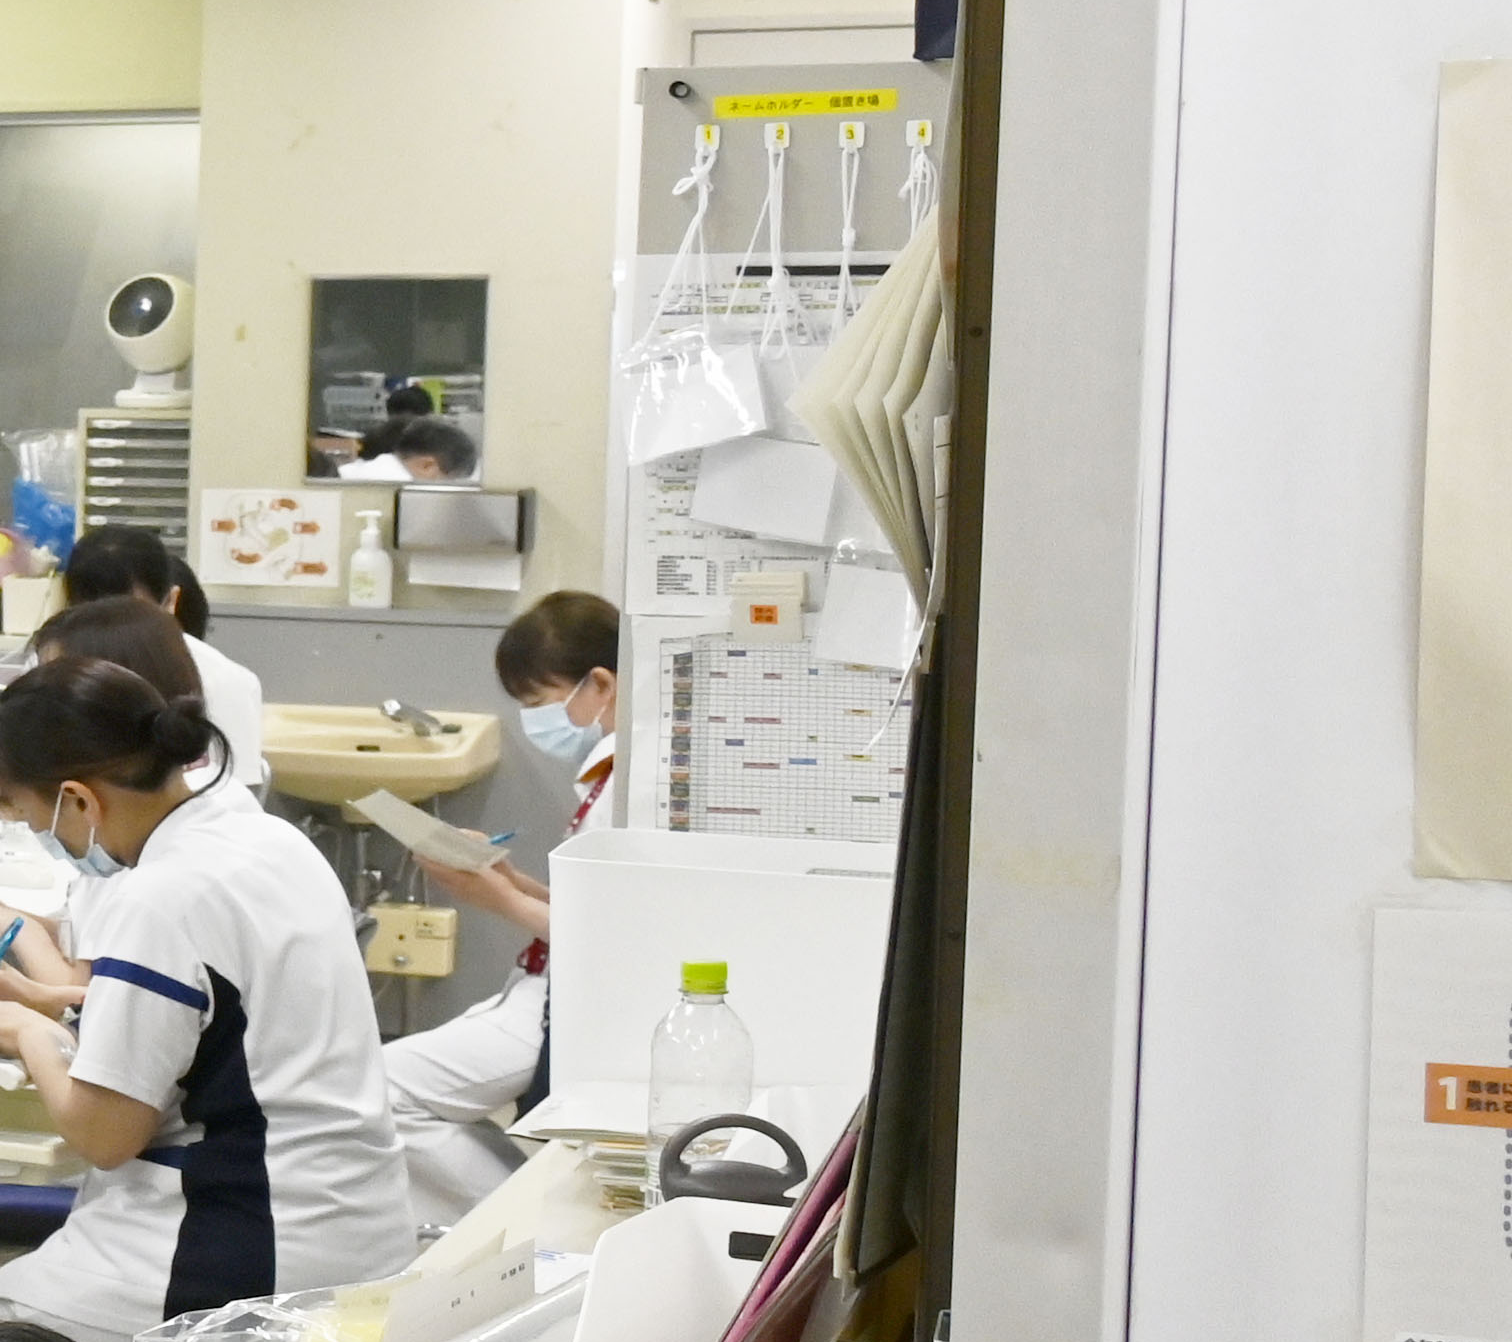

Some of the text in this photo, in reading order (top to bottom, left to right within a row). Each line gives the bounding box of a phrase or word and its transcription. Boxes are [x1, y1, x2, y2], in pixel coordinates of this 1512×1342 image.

[728, 98, 814, 111] ネームホルダー
[706, 128, 926, 140] 1 2 3 4
[1438, 1076, 1457, 1111] 1
